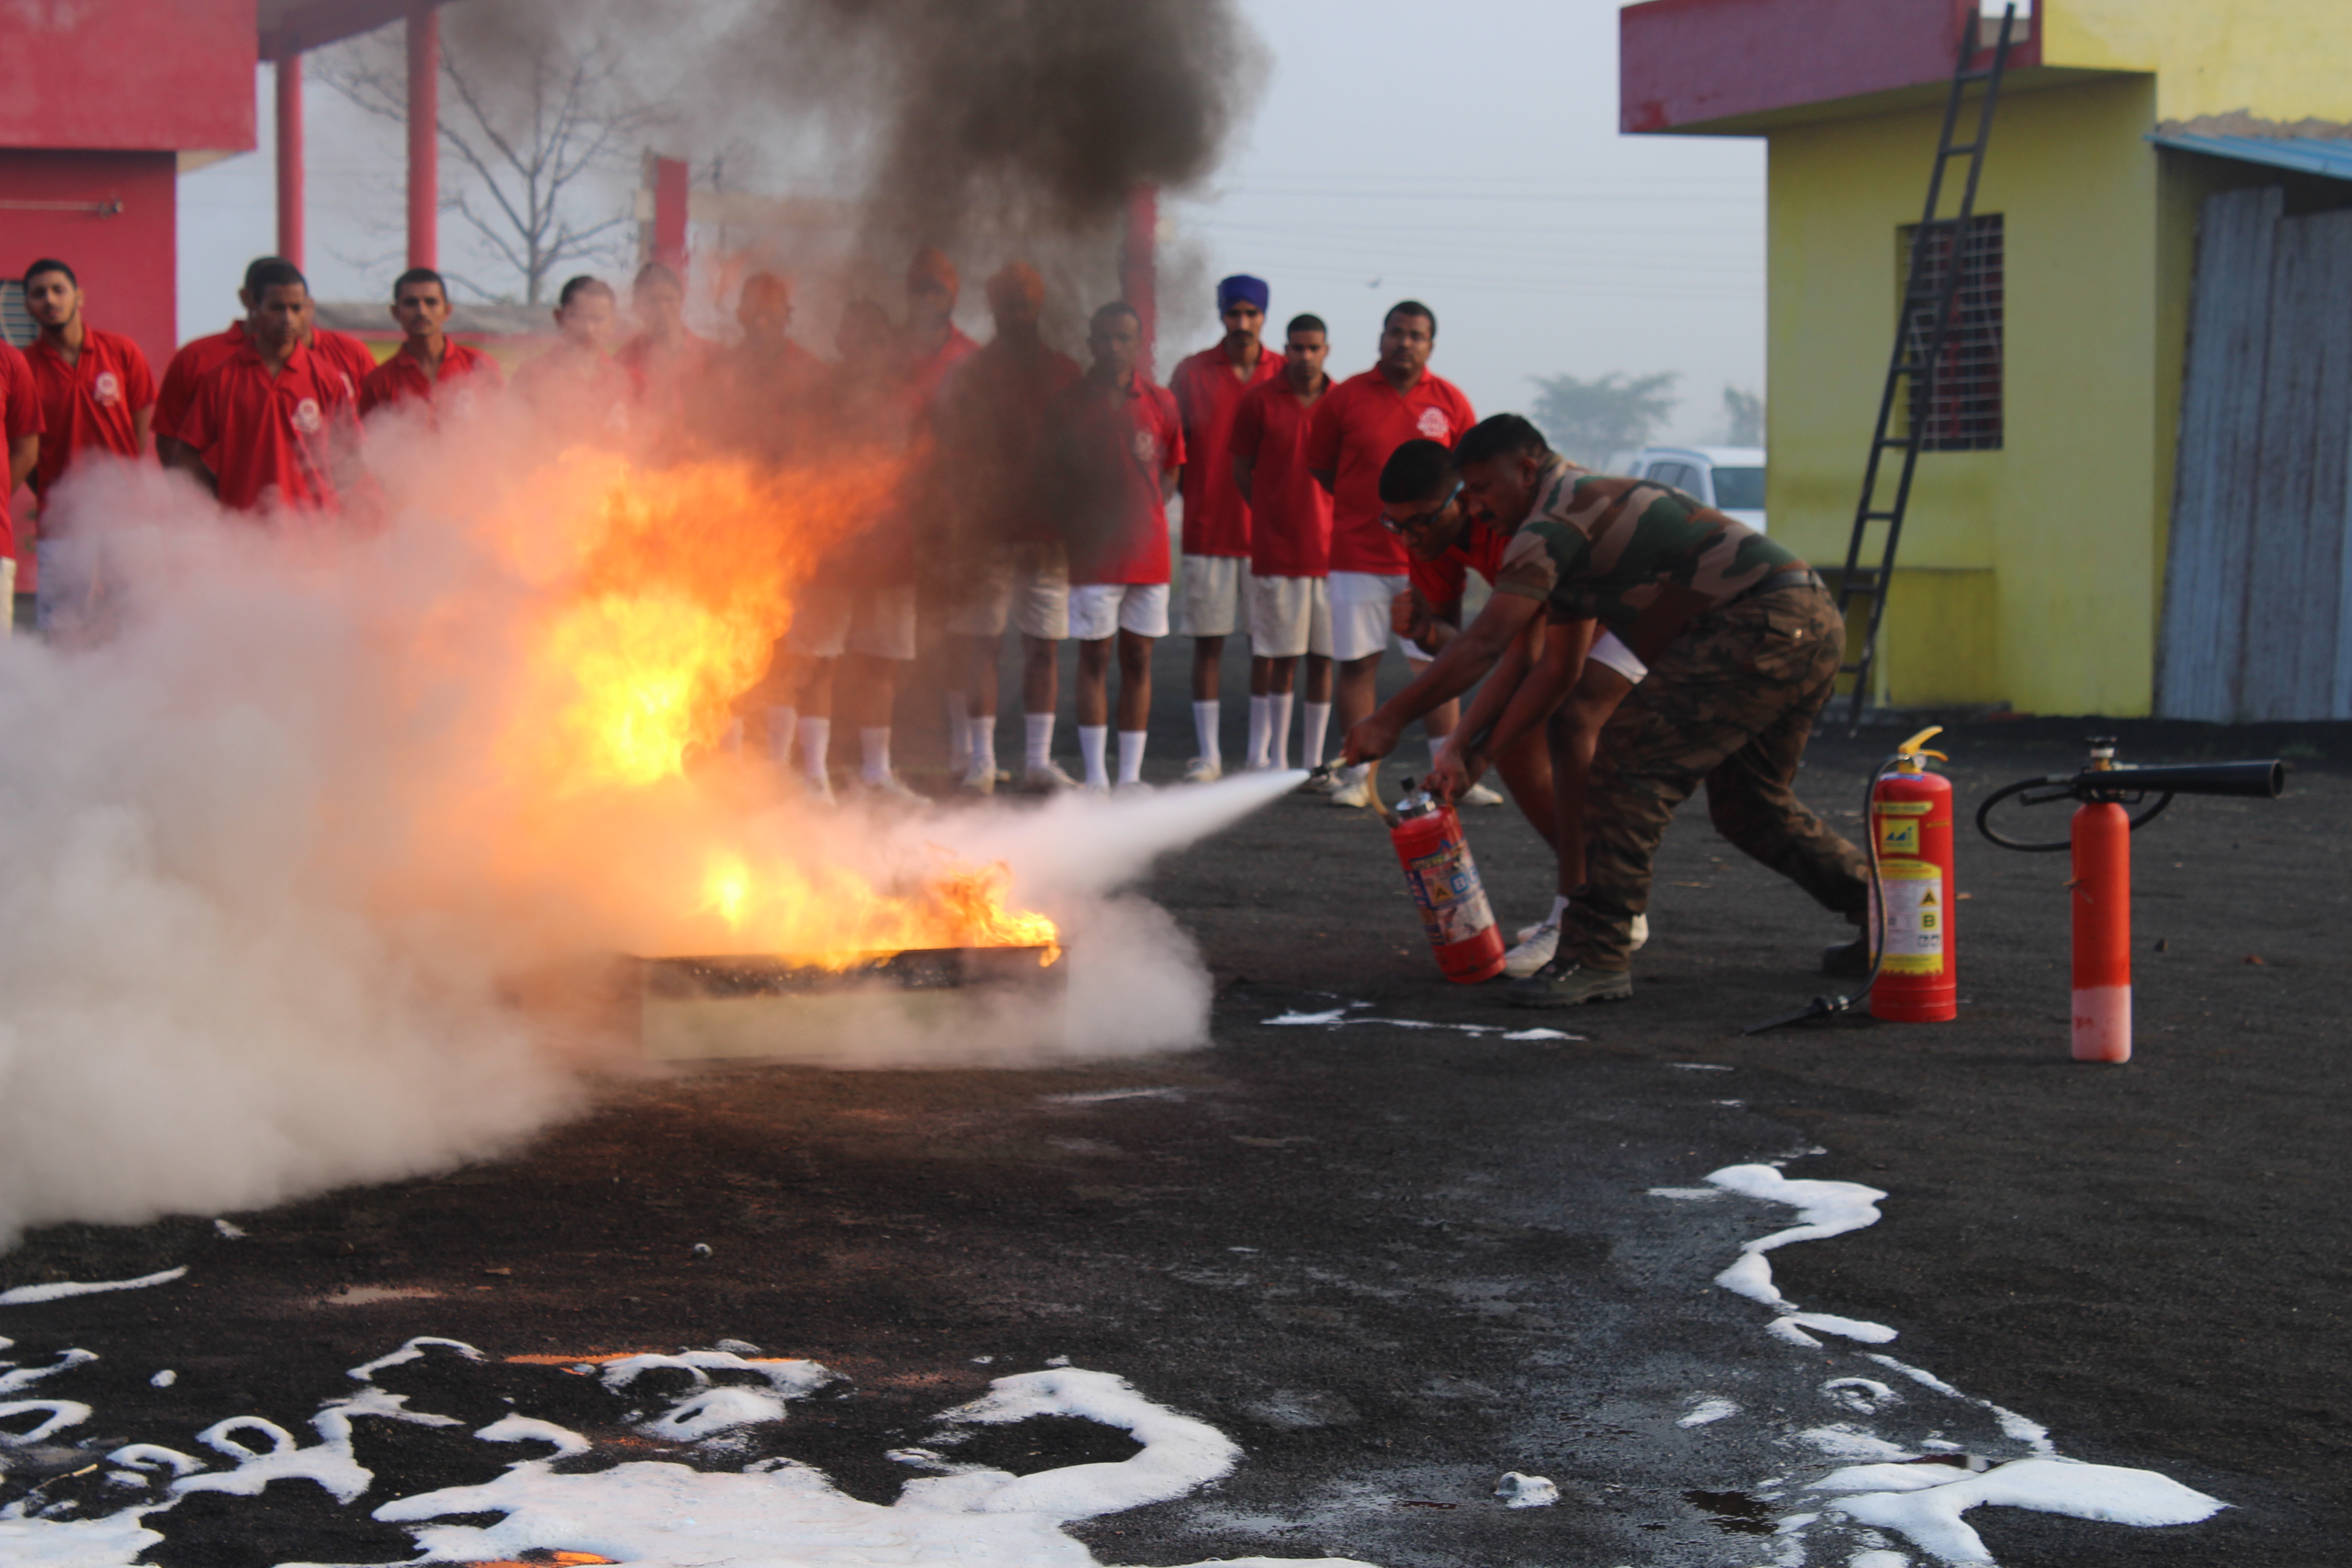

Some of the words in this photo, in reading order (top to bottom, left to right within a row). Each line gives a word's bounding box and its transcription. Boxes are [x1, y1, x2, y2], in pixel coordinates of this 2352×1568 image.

[1436, 887, 1449, 899] A
[1453, 877, 1467, 891] B
[1923, 892, 1936, 904] A
[1924, 914, 1935, 927] B
